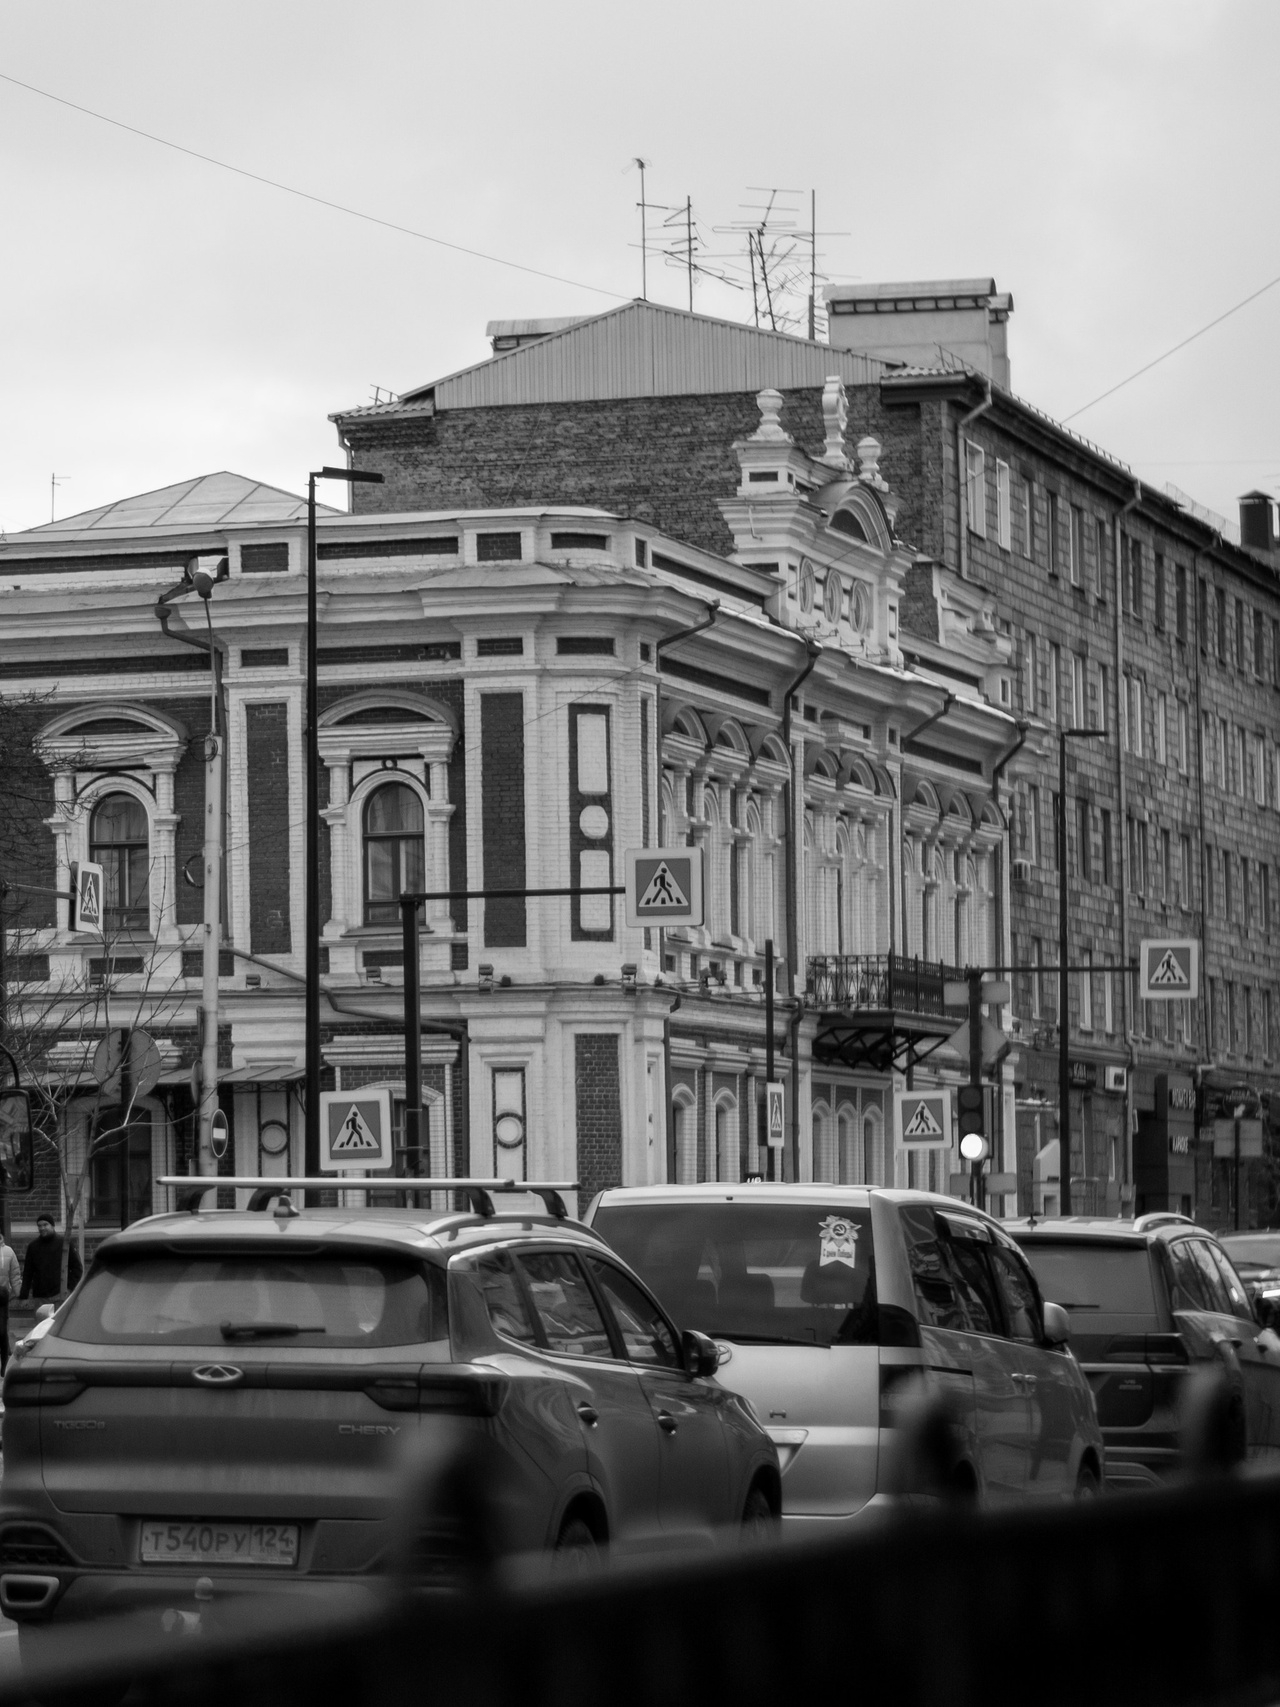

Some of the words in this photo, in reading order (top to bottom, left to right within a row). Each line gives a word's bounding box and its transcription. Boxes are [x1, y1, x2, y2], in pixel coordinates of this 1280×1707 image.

[338, 1424, 401, 1436] CHERY
[150, 1525, 247, 1552] Т540РУ
[253, 1526, 291, 1549] 124
